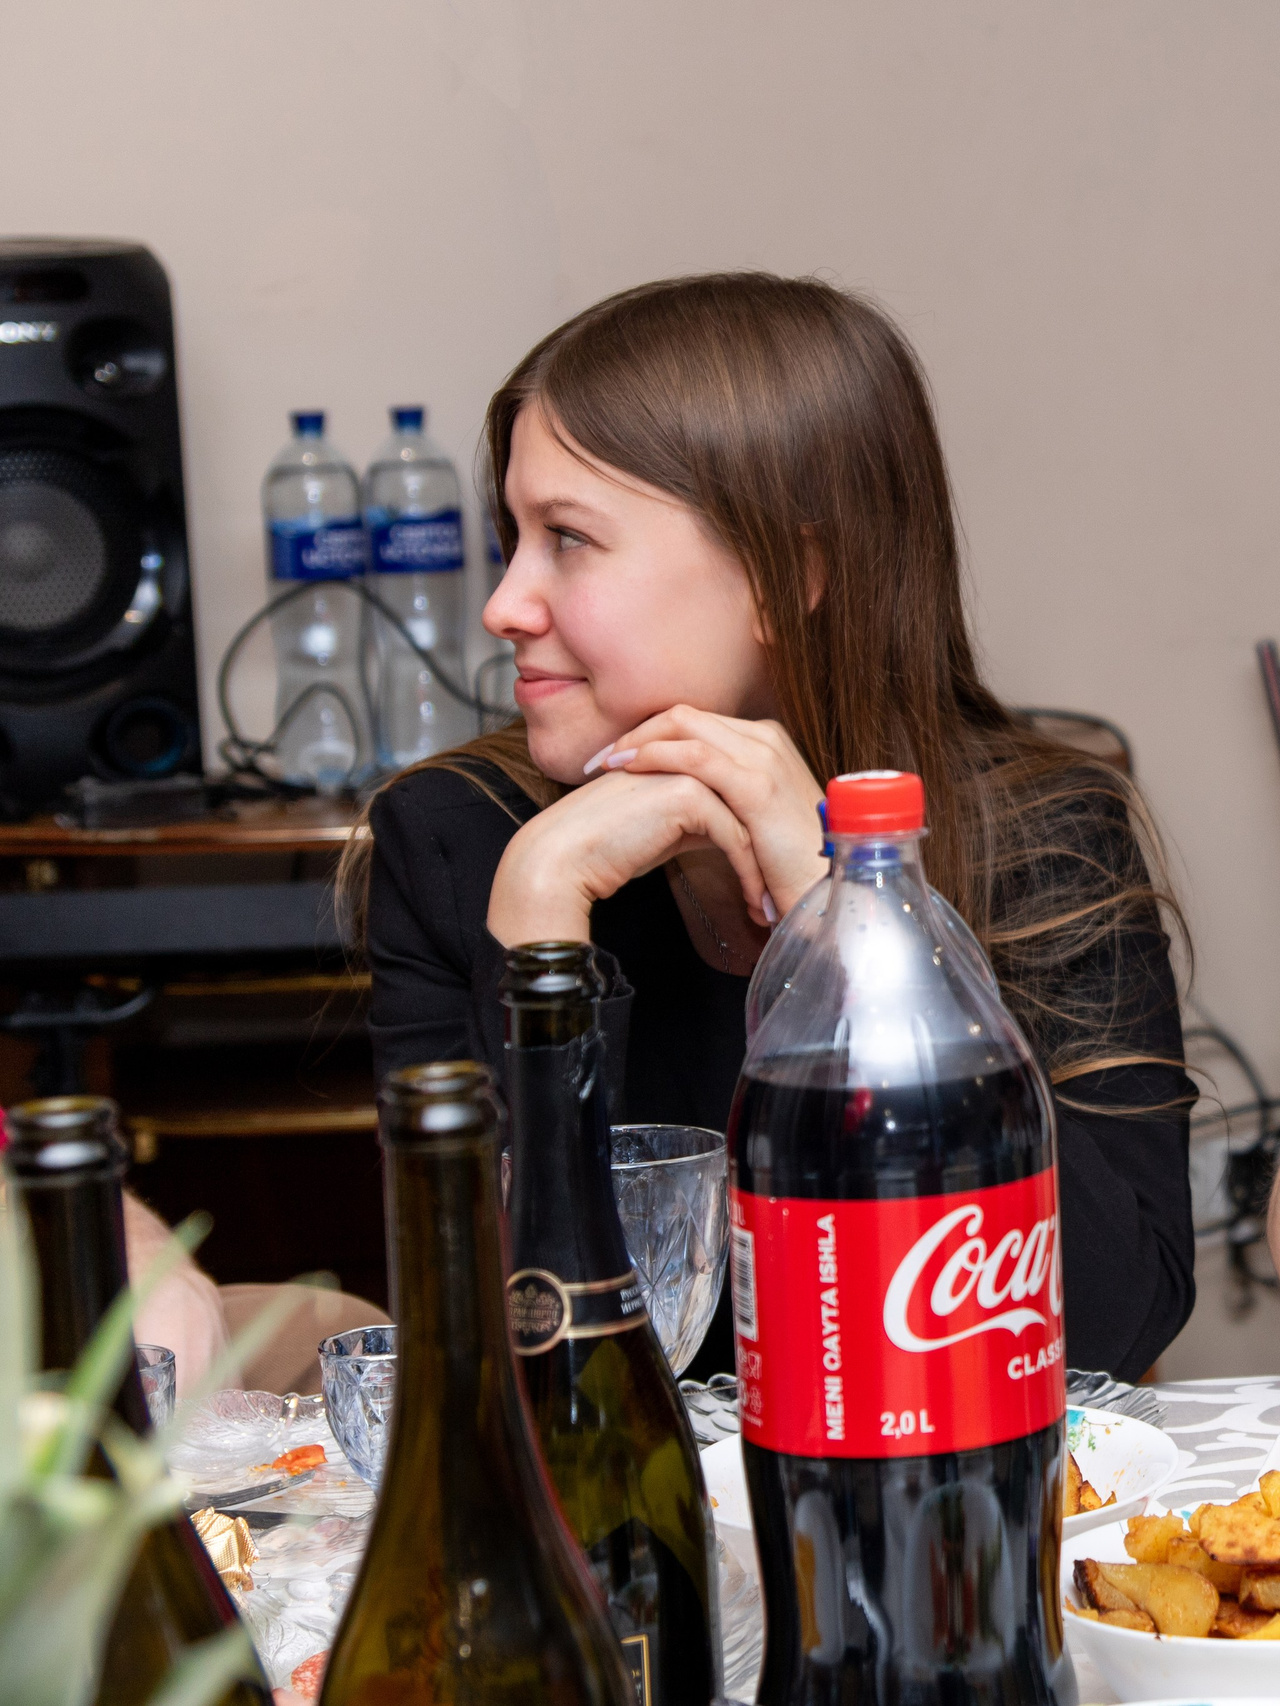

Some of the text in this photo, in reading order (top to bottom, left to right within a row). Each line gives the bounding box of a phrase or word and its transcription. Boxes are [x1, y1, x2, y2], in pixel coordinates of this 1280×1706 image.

[0, 321, 58, 342] ONY
[816, 1212, 846, 1441] MENI QAYTA ISHLA
[1007, 1338, 1062, 1380] CLASS
[880, 1408, 936, 1440] 2,0 L
